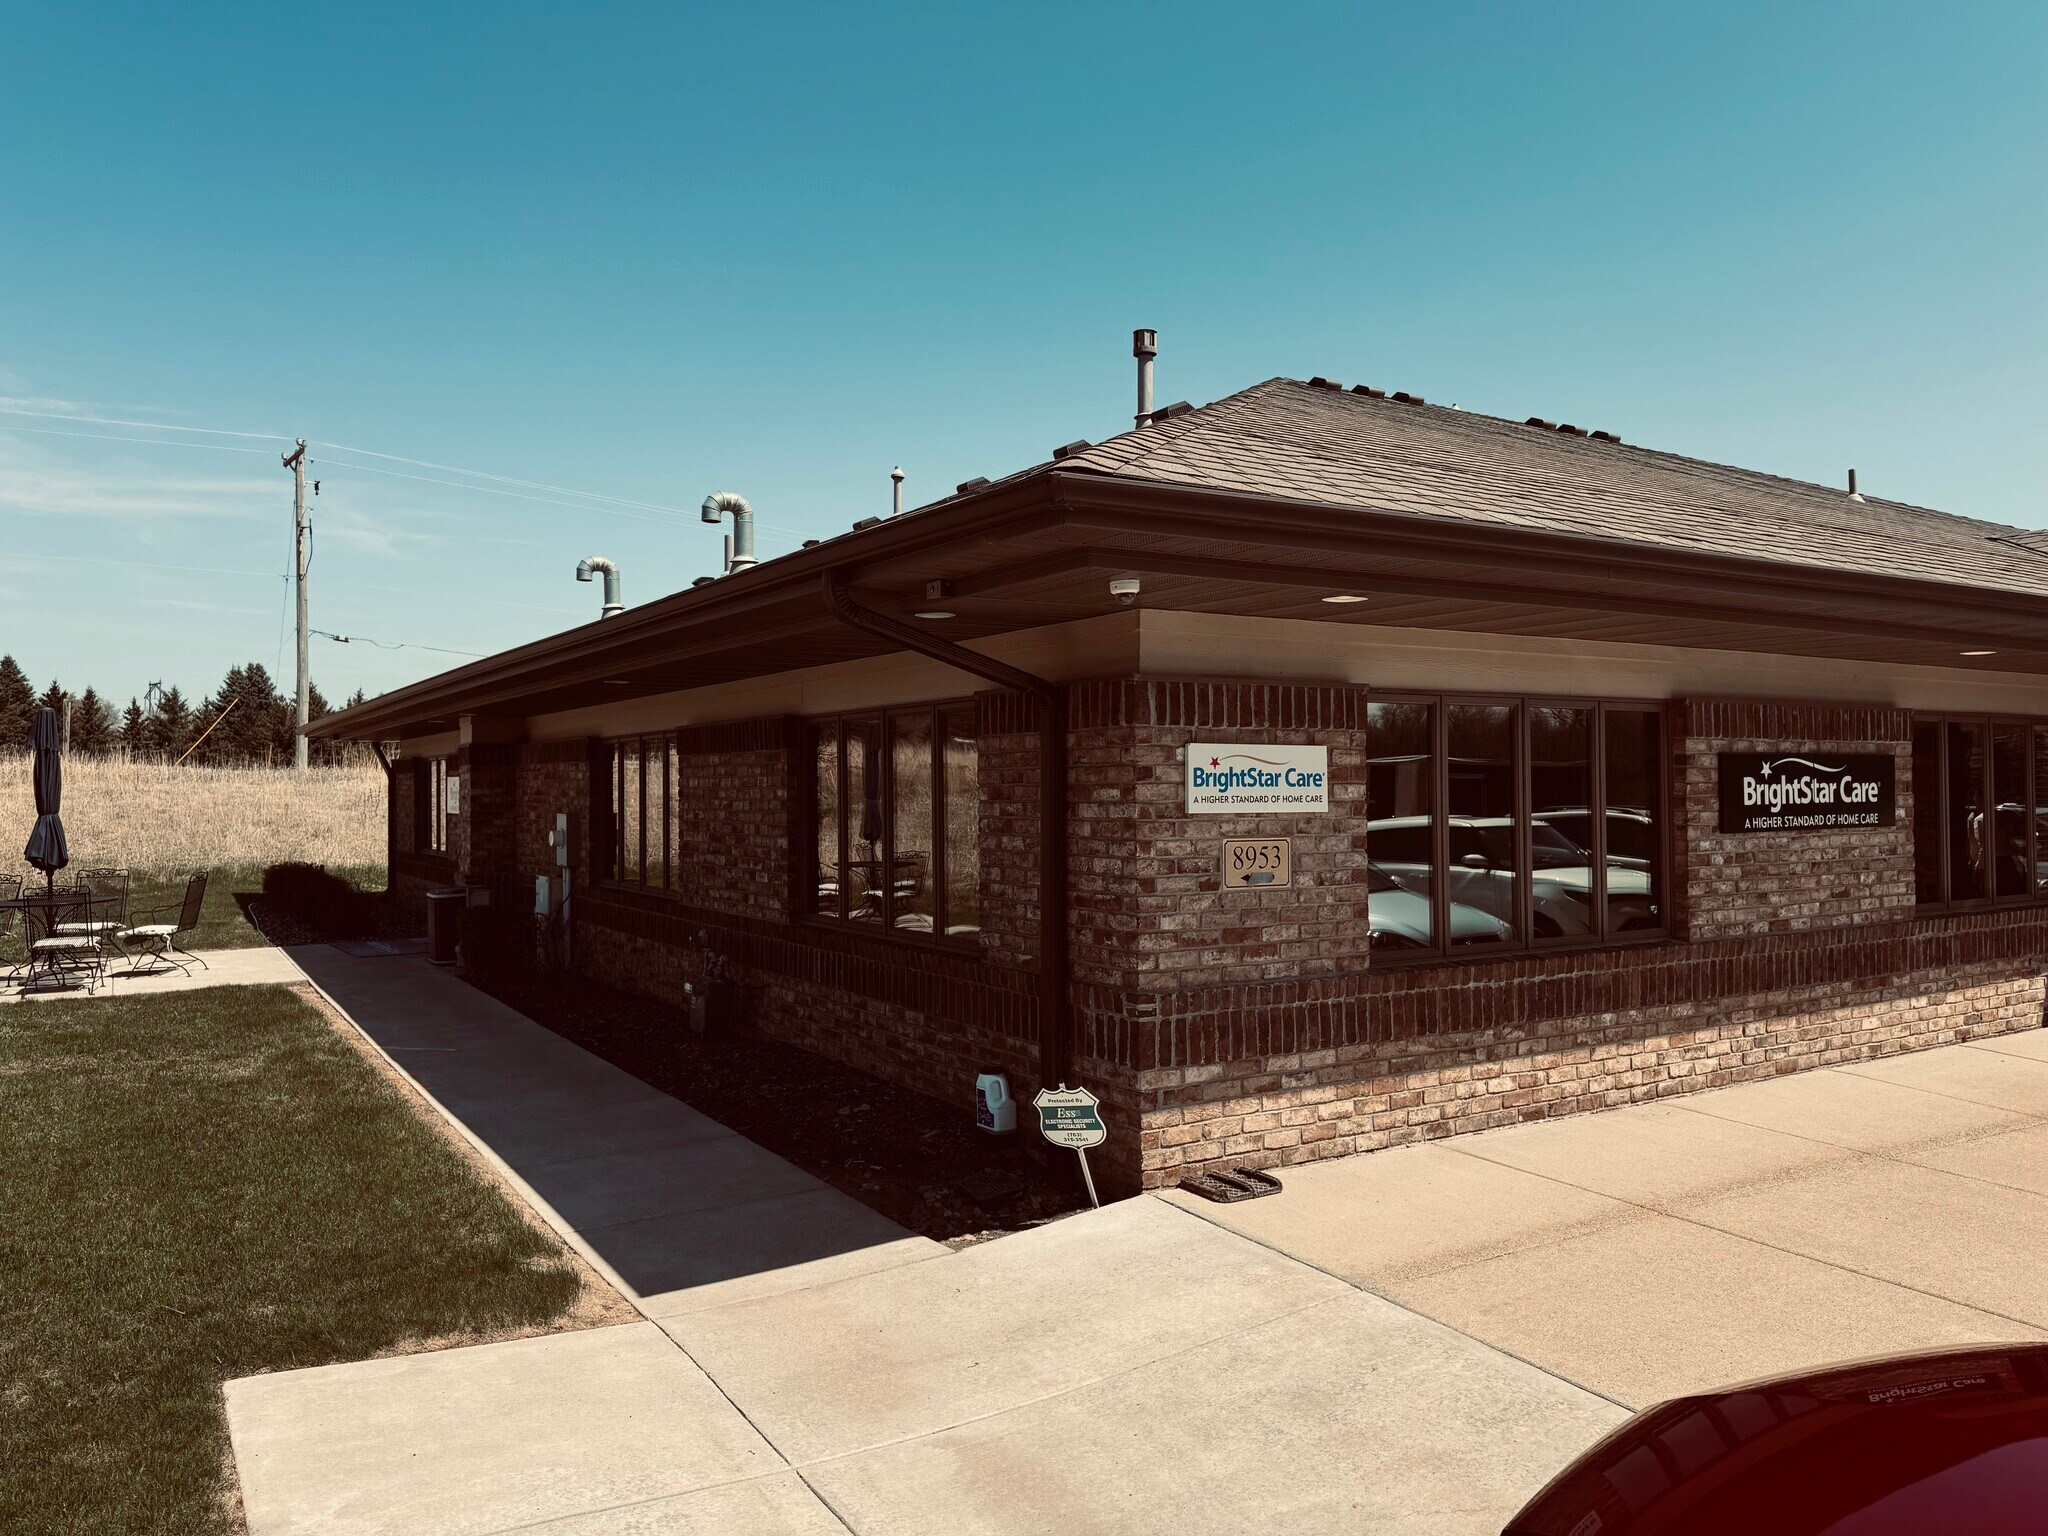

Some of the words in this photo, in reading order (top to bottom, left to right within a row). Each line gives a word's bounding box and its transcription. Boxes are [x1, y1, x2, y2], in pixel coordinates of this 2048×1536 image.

[1193, 766, 1282, 793] BrightStar
[1285, 767, 1323, 788] Care
[1193, 796, 1200, 804] A
[1201, 795, 1230, 804] HIGHER
[1231, 795, 1270, 804] STANDARD
[1271, 795, 1281, 803] OF
[1282, 795, 1304, 803] HOME
[1305, 795, 1323, 803] CARE
[1743, 775, 1837, 813] BrightStar
[1840, 775, 1879, 803] Care
[1744, 817, 1751, 829] A
[1753, 816, 1783, 829] HIGHER
[1784, 815, 1825, 827] STANDARD
[1826, 814, 1836, 825] OF
[1838, 813, 1859, 825] HOME
[1860, 813, 1879, 824] CARE
[1233, 845, 1281, 870] 8953
